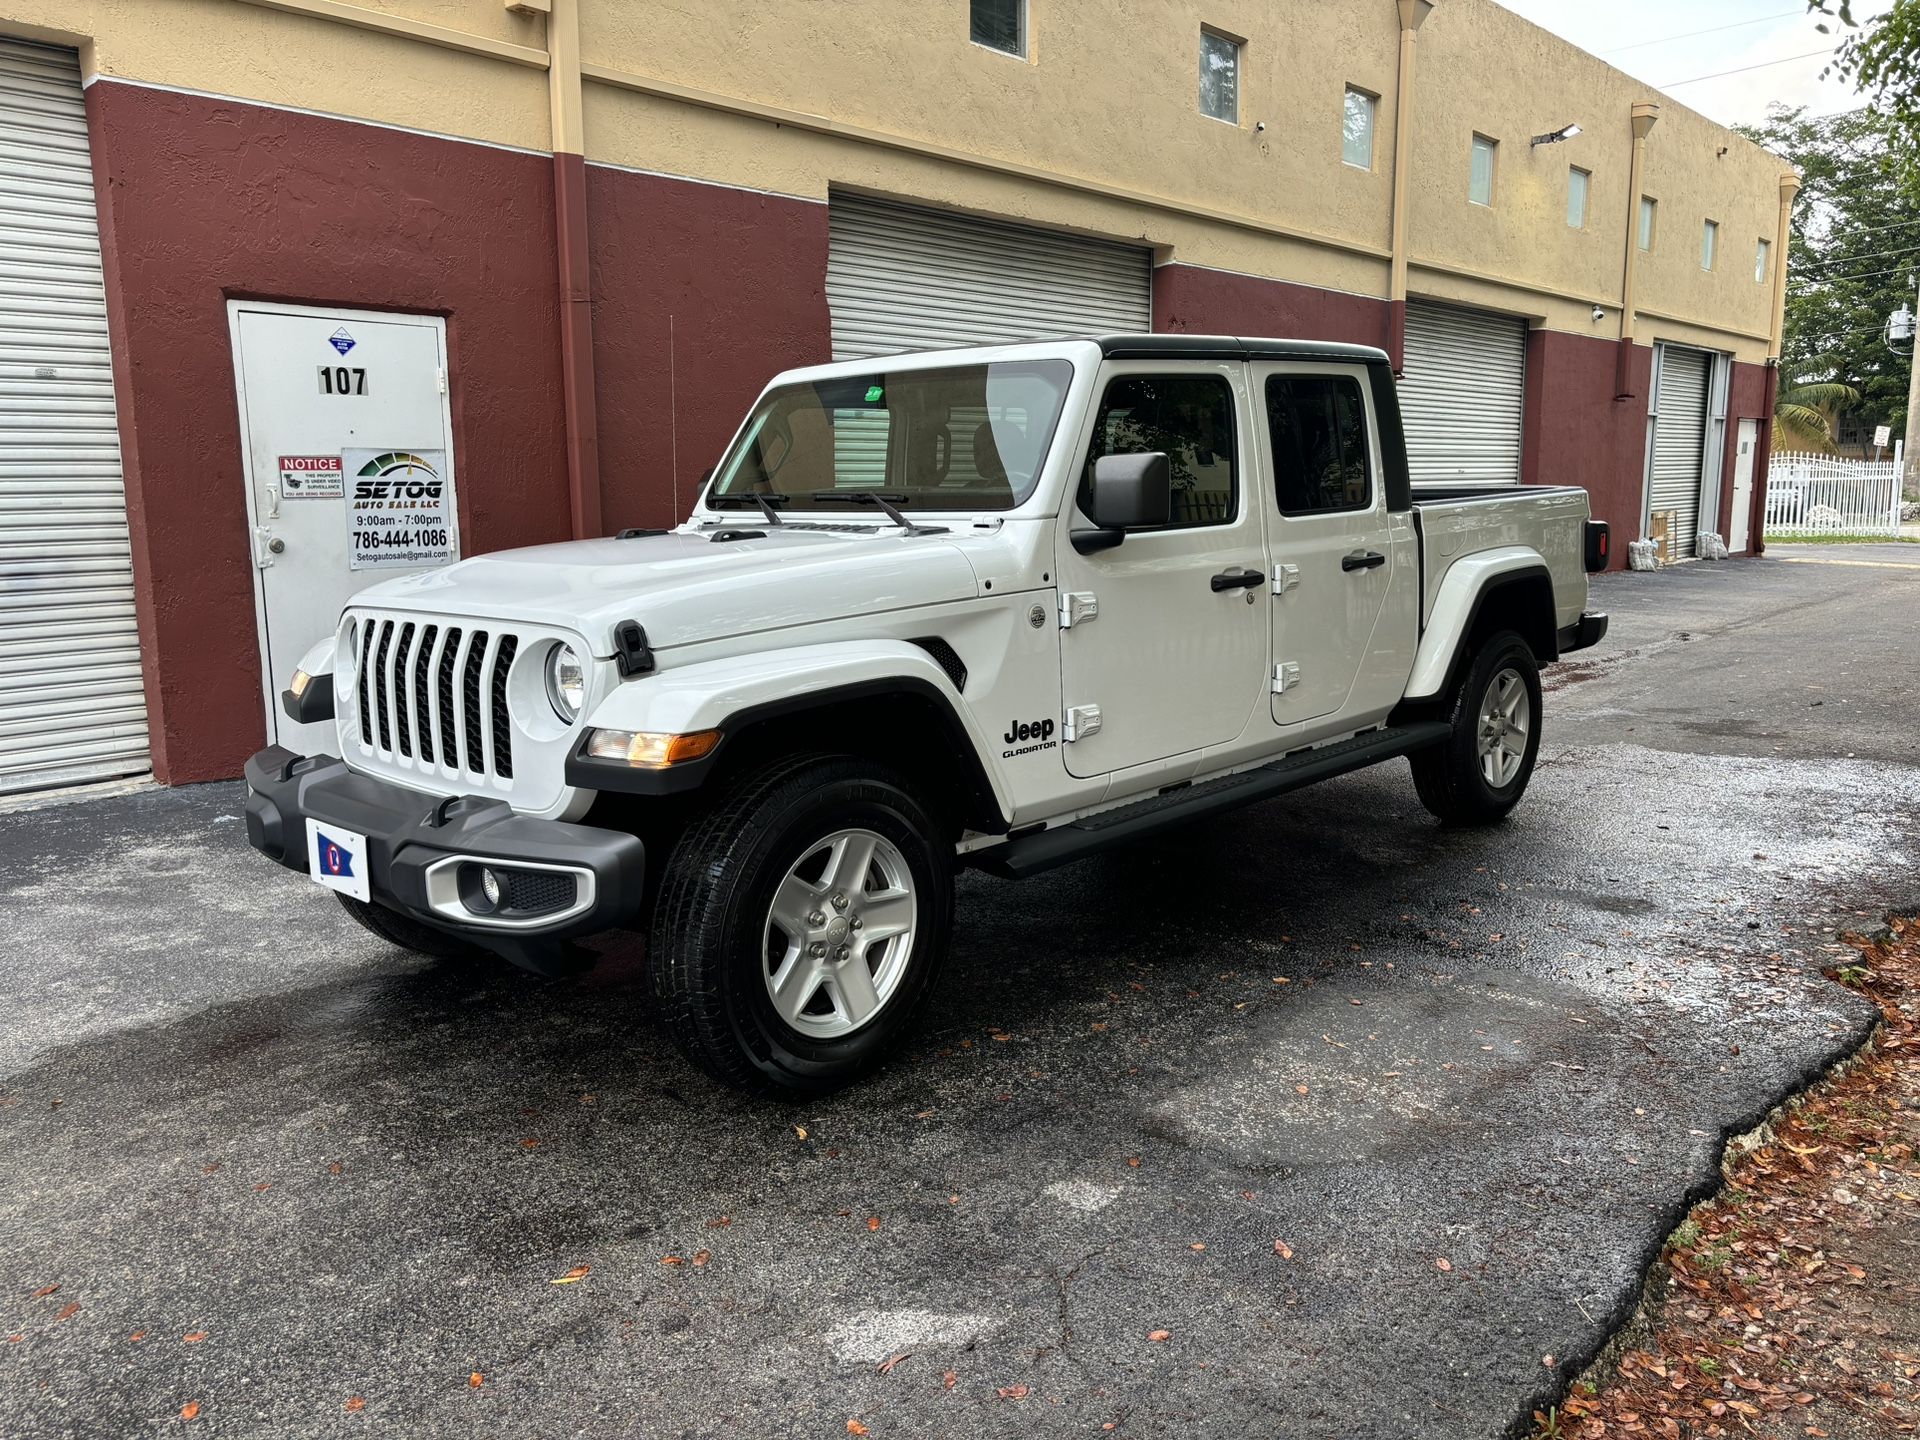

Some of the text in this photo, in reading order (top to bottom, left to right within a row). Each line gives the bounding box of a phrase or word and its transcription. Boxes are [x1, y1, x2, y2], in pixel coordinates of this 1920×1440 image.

[321, 366, 365, 395] 107
[284, 459, 338, 470] NOTICE
[353, 481, 443, 499] SETOG
[353, 500, 440, 510] AUTO SALE LLC
[356, 515, 396, 526] 9:00am
[404, 514, 442, 527] 7:00pm
[352, 529, 447, 549] 786-444-1086
[356, 550, 448, 562] Setogautosale@gmail.com
[1004, 718, 1055, 744] Jeep
[1003, 741, 1057, 758] GLADIATOR
